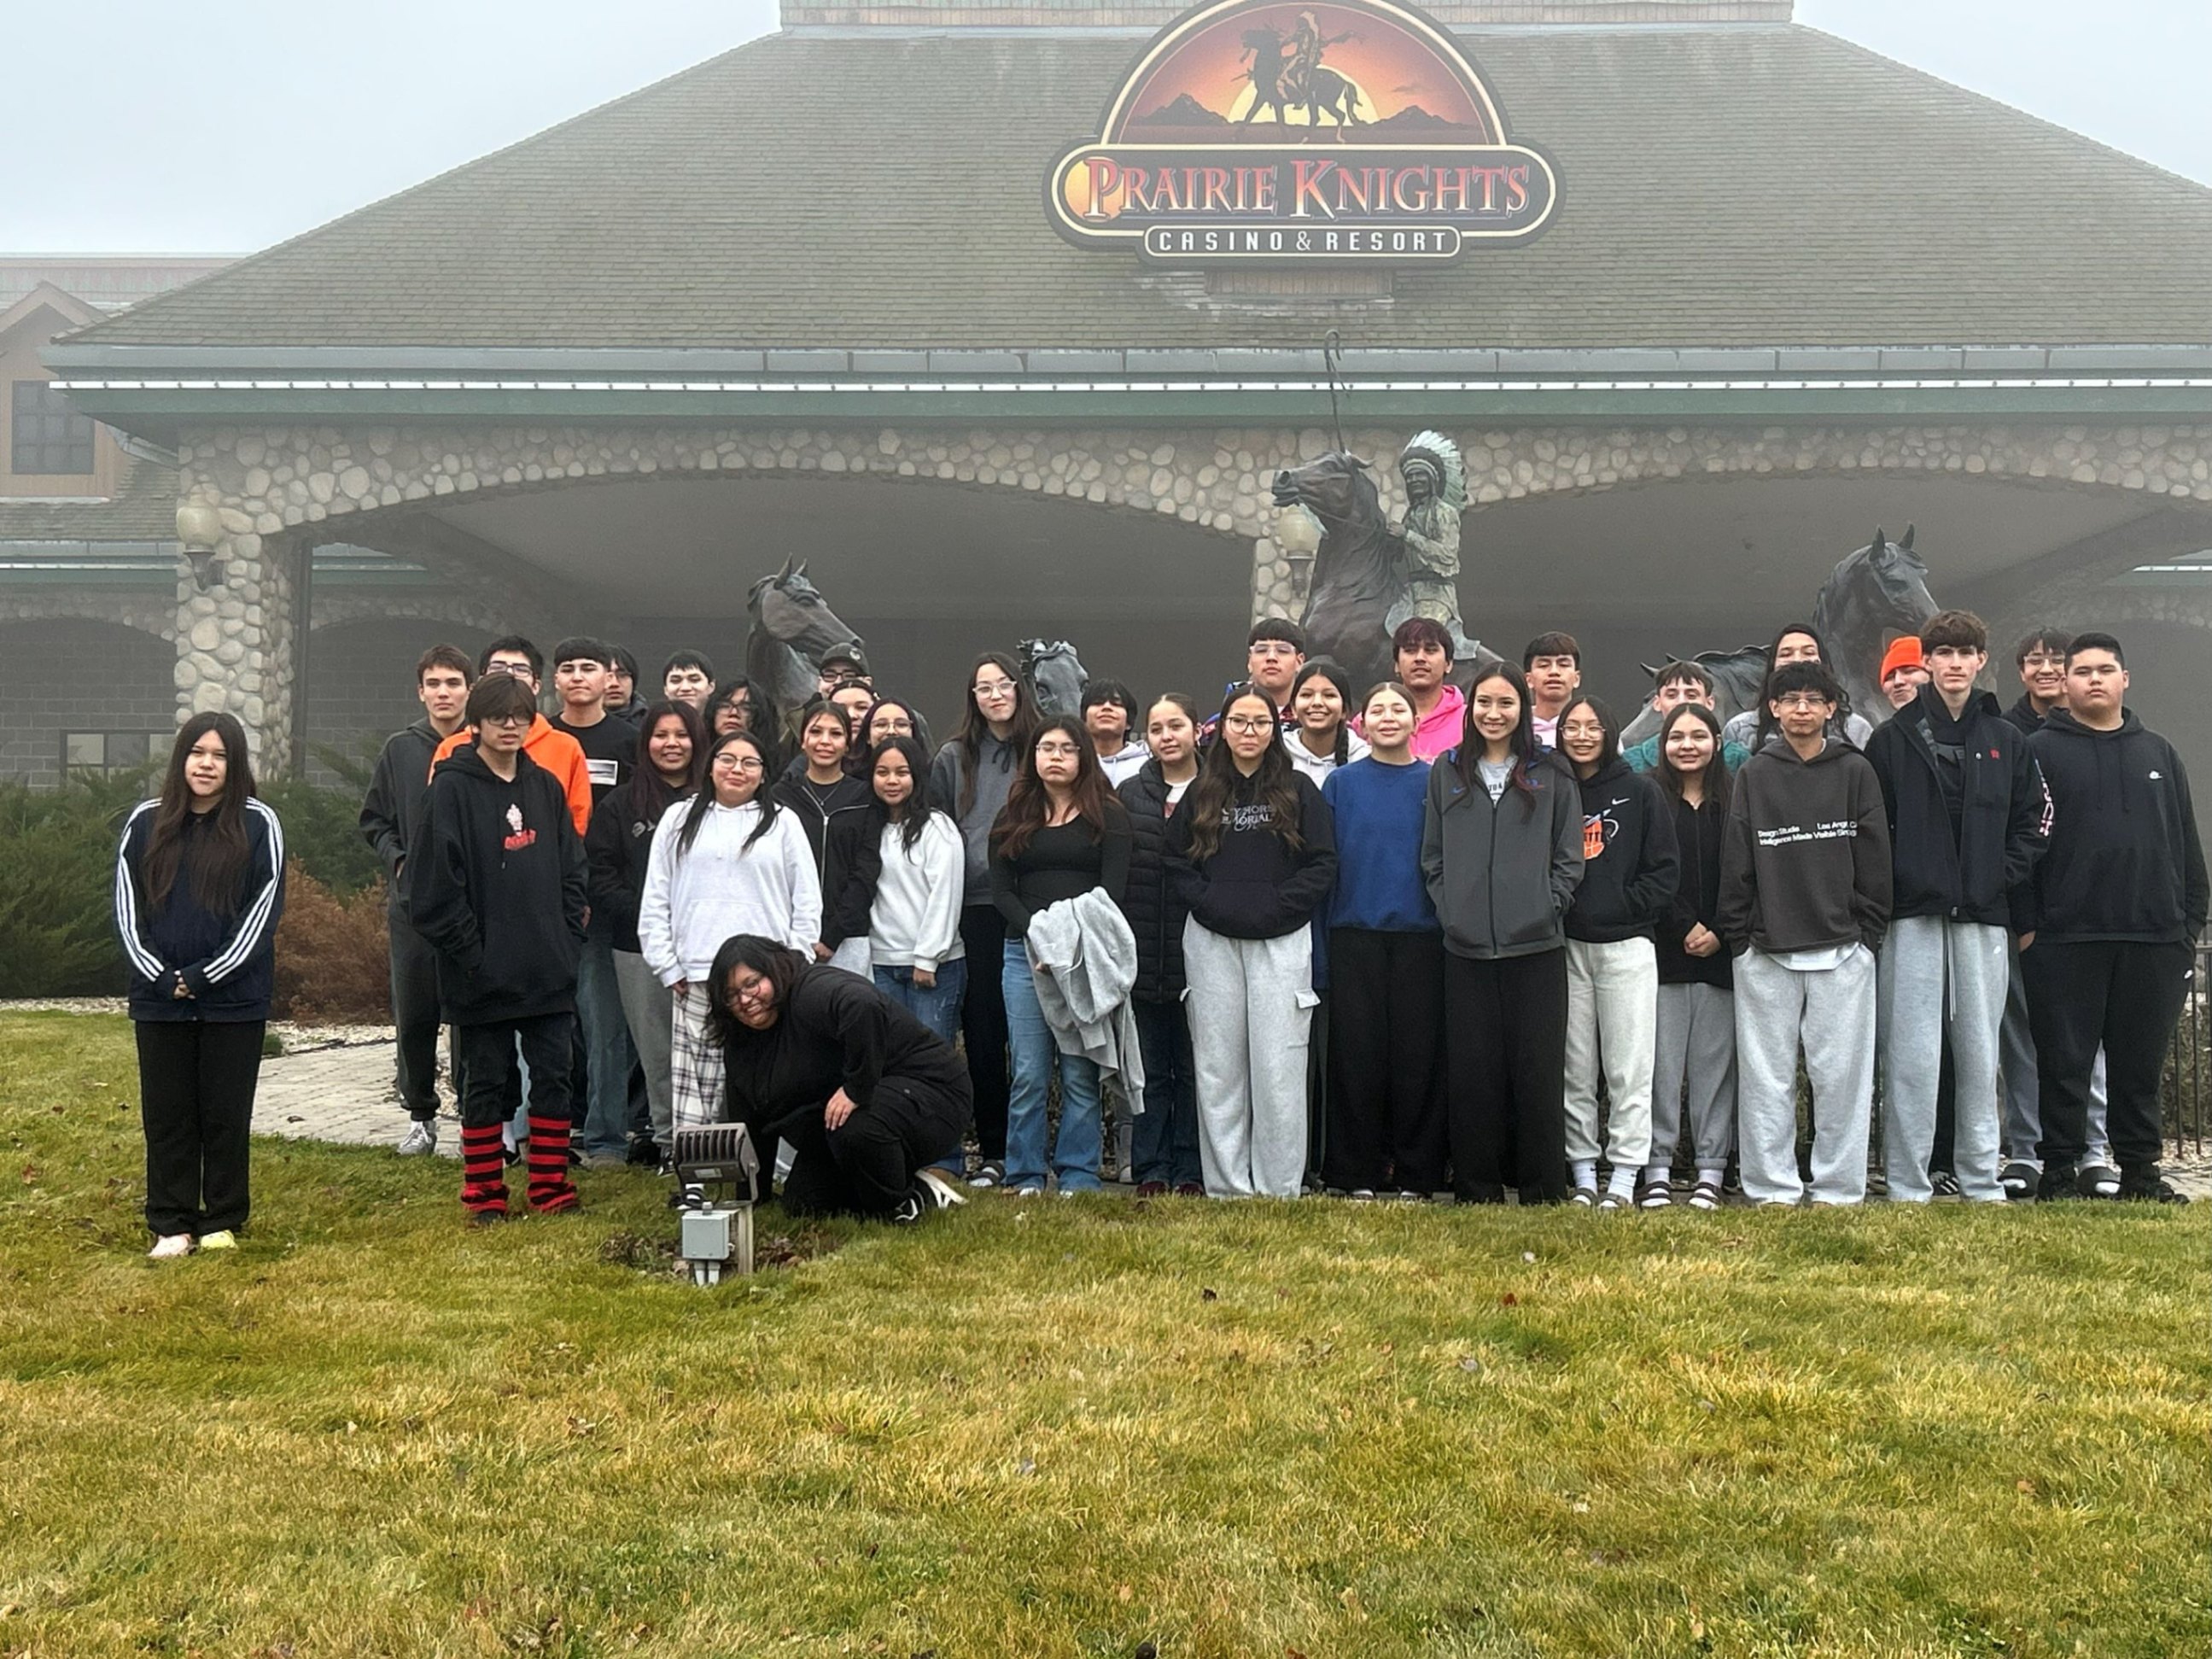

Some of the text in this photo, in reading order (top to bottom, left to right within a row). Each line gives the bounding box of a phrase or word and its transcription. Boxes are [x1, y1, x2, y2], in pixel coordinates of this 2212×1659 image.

[1083, 156, 1530, 220] PRAIRIE KNIGHTS
[1159, 231, 1446, 251] CASINO & RESORT
